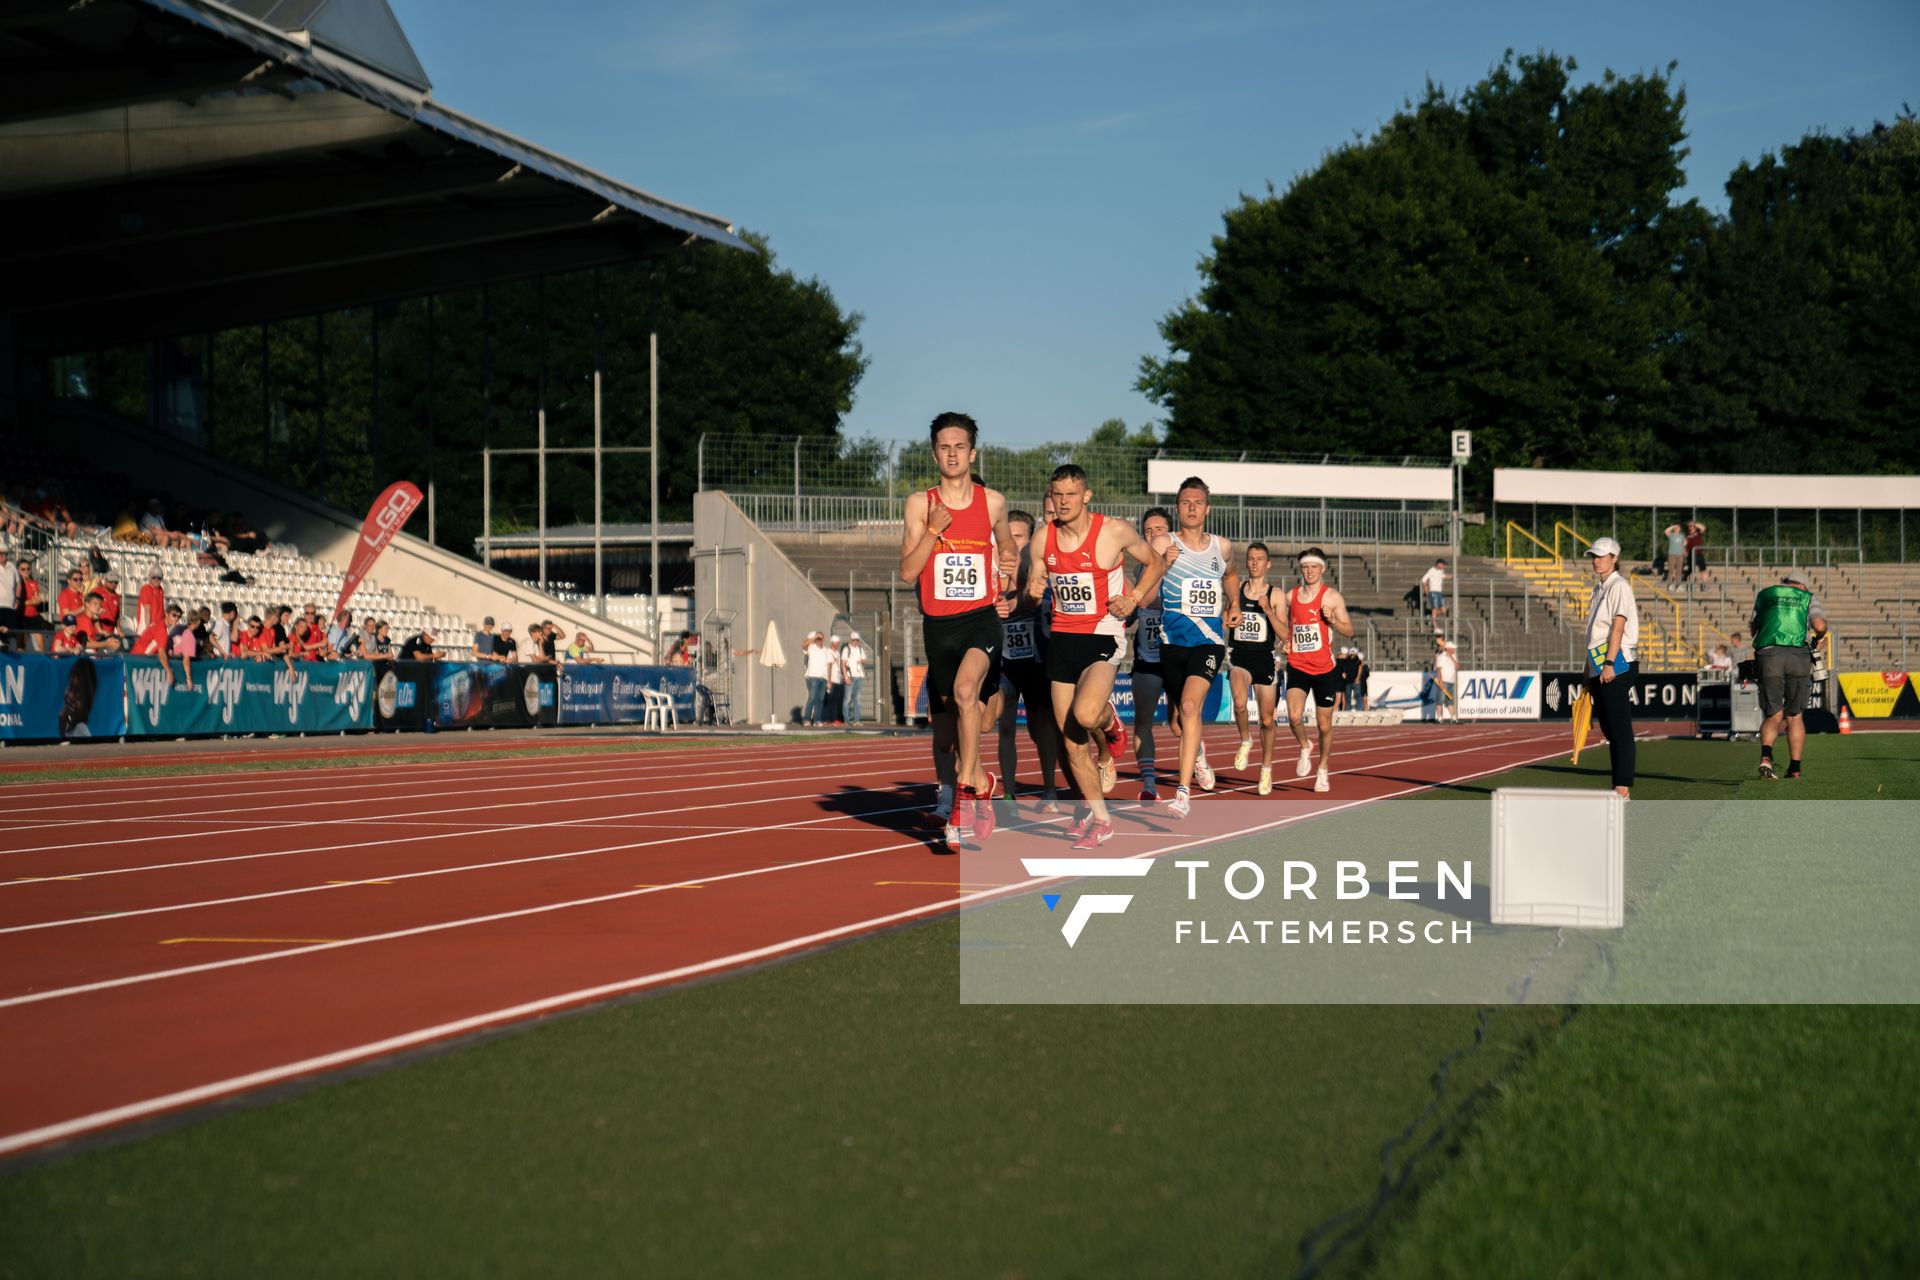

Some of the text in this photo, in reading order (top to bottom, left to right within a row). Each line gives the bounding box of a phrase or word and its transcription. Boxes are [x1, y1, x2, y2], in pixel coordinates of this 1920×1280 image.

[1456, 435, 1465, 452] E
[364, 488, 410, 547] LGO
[945, 555, 972, 567] GLS
[943, 567, 977, 585] 546
[1056, 575, 1079, 585] GLS
[1192, 580, 1212, 589] GLS
[1054, 585, 1092, 601] 1086
[1189, 590, 1217, 605] 598
[1007, 624, 1026, 633] GLS
[1295, 625, 1311, 633] GLS
[1007, 632, 1031, 648] 381
[1293, 631, 1319, 644] 1084
[1461, 678, 1507, 699] ANA
[1568, 683, 1697, 706] NAFON
[1856, 687, 1889, 695] HERZLICH
[1851, 696, 1895, 705] WILLKOMMEN
[1459, 705, 1532, 715] Inspiration of JAPAN
